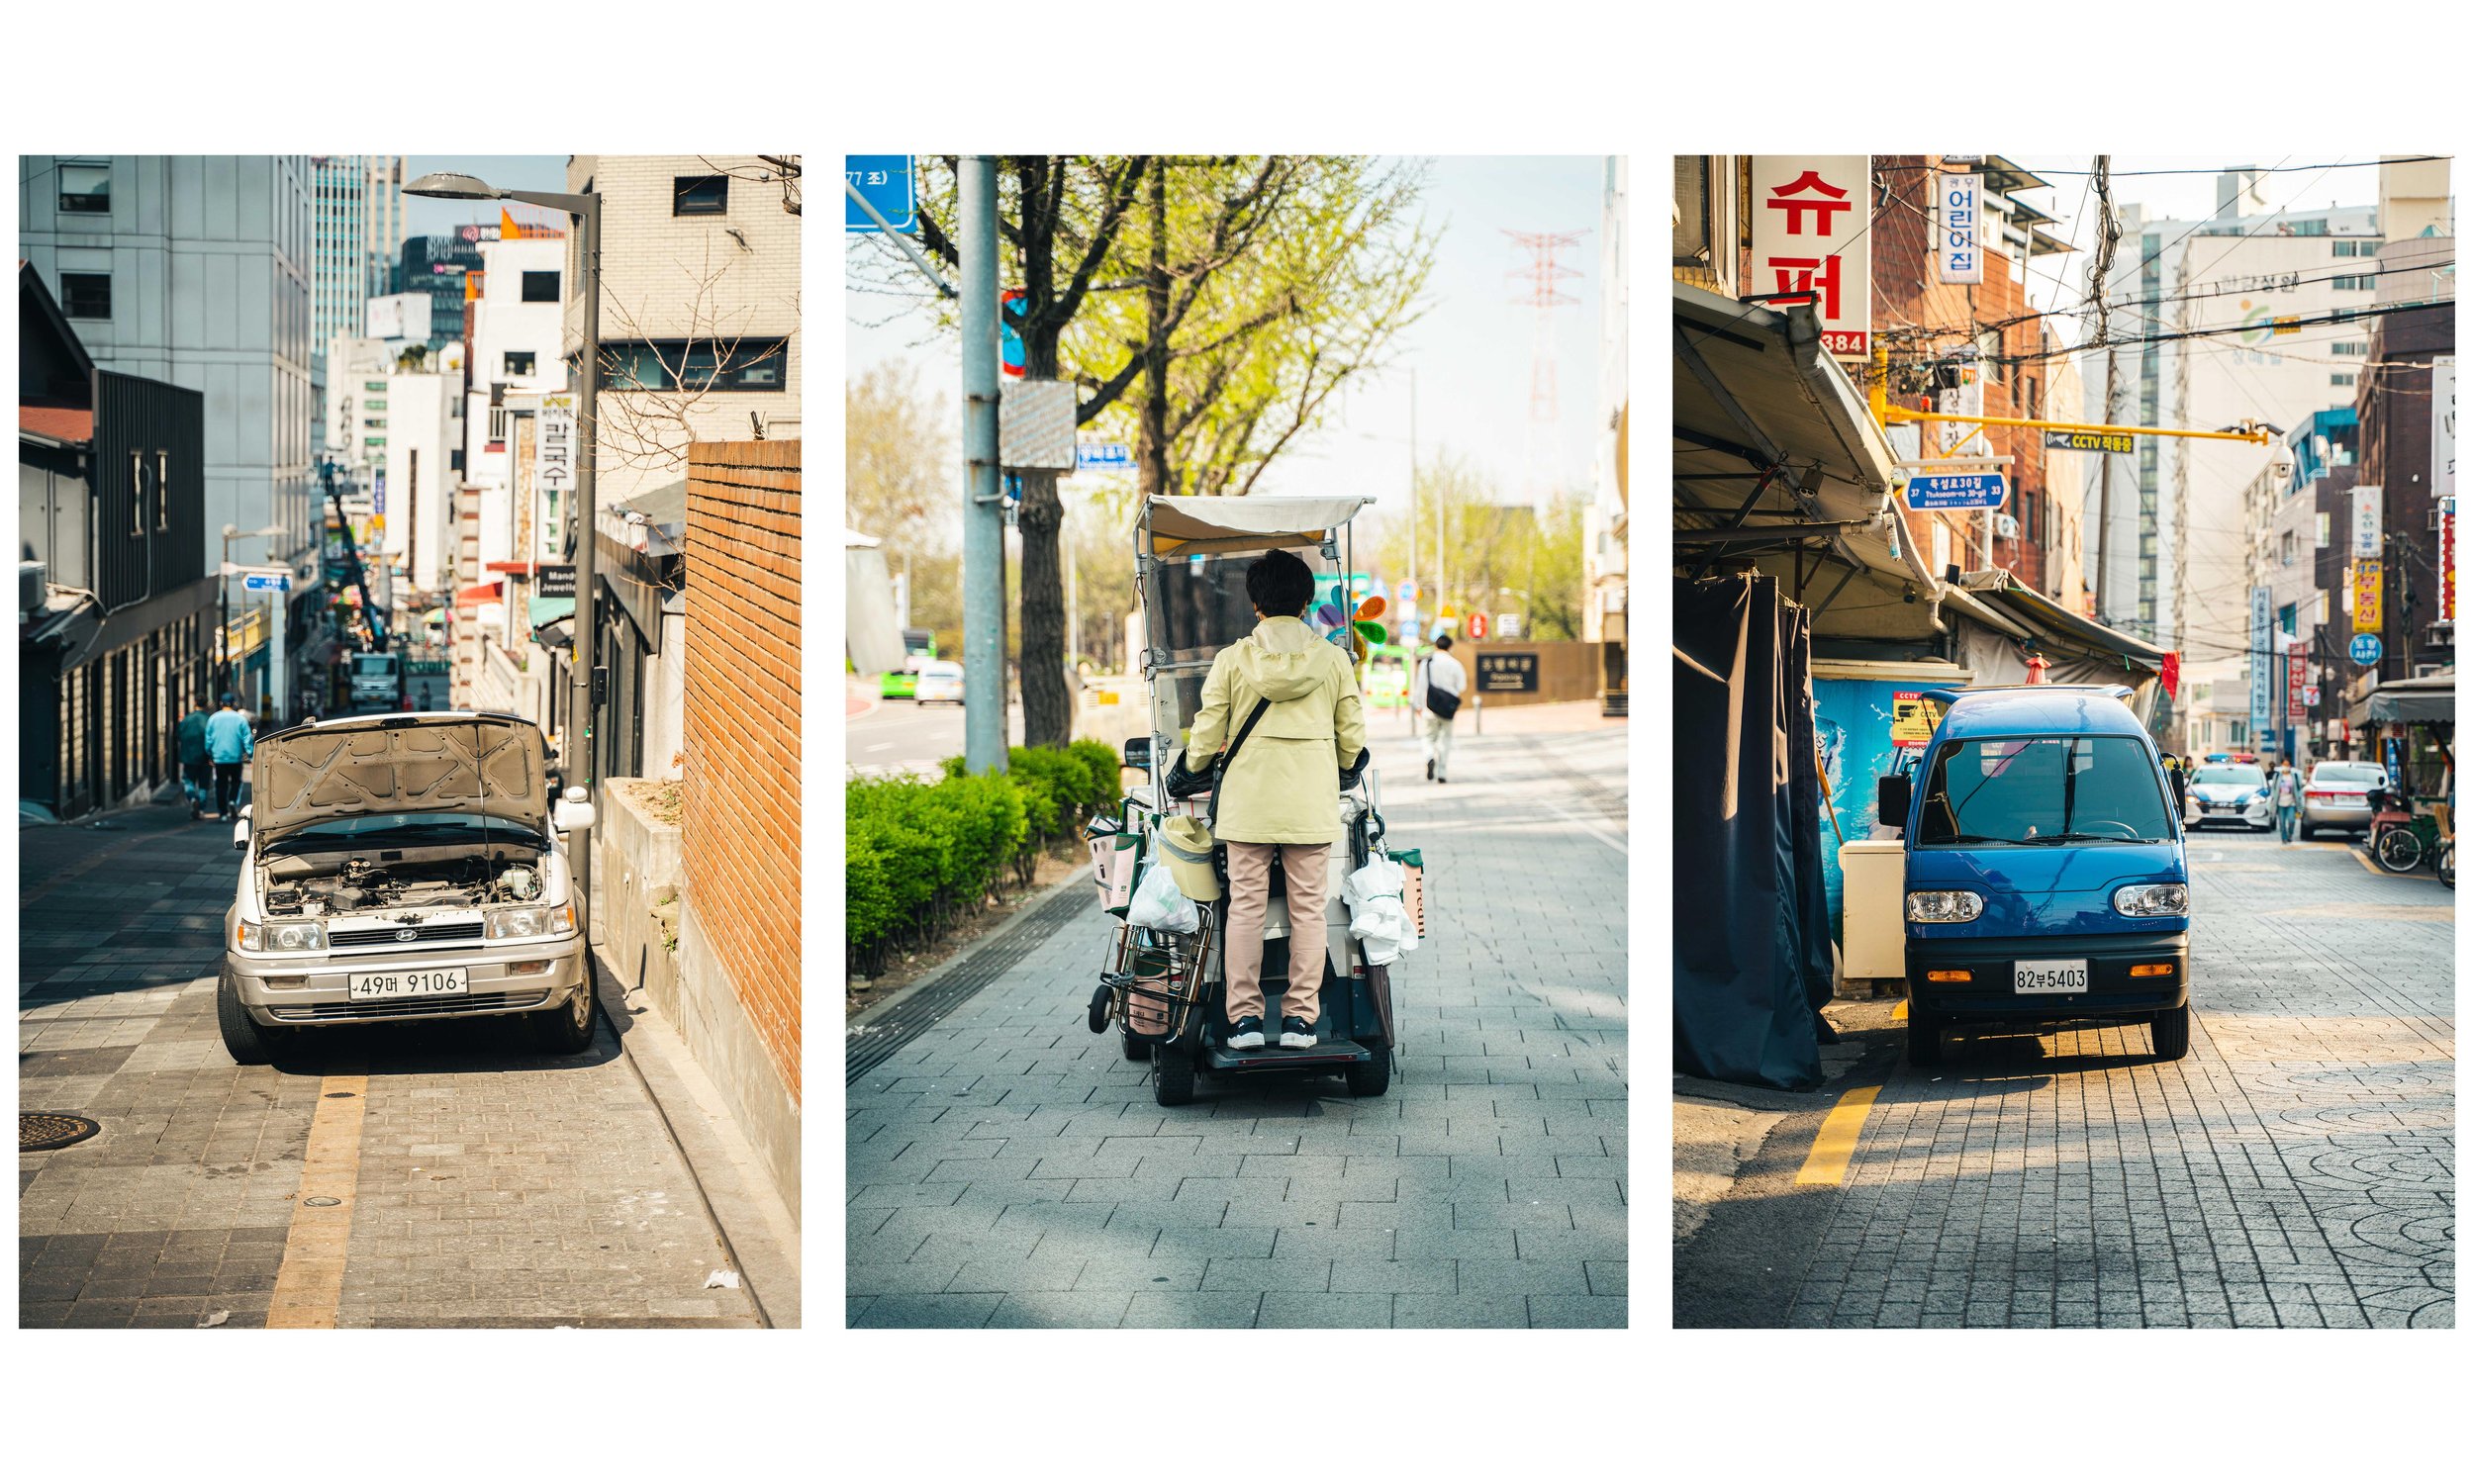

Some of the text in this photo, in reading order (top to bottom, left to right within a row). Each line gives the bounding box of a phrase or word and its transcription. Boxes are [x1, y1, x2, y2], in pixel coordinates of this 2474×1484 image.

[867, 169, 888, 186] 조)
[1950, 190, 1971, 270] 어린이집
[1766, 170, 1852, 320] 슈퍼
[2072, 434, 2132, 452] CCTV 작동중
[542, 422, 568, 486] 칼국수
[1930, 477, 1981, 490] 뚝섬로30길
[1991, 486, 2001, 495] 33
[1910, 488, 1920, 498] 37
[548, 571, 576, 580] Mand
[2359, 576, 2375, 623] 부동산
[360, 973, 457, 995] 49머 9106
[2017, 970, 2085, 988] 82부5403
